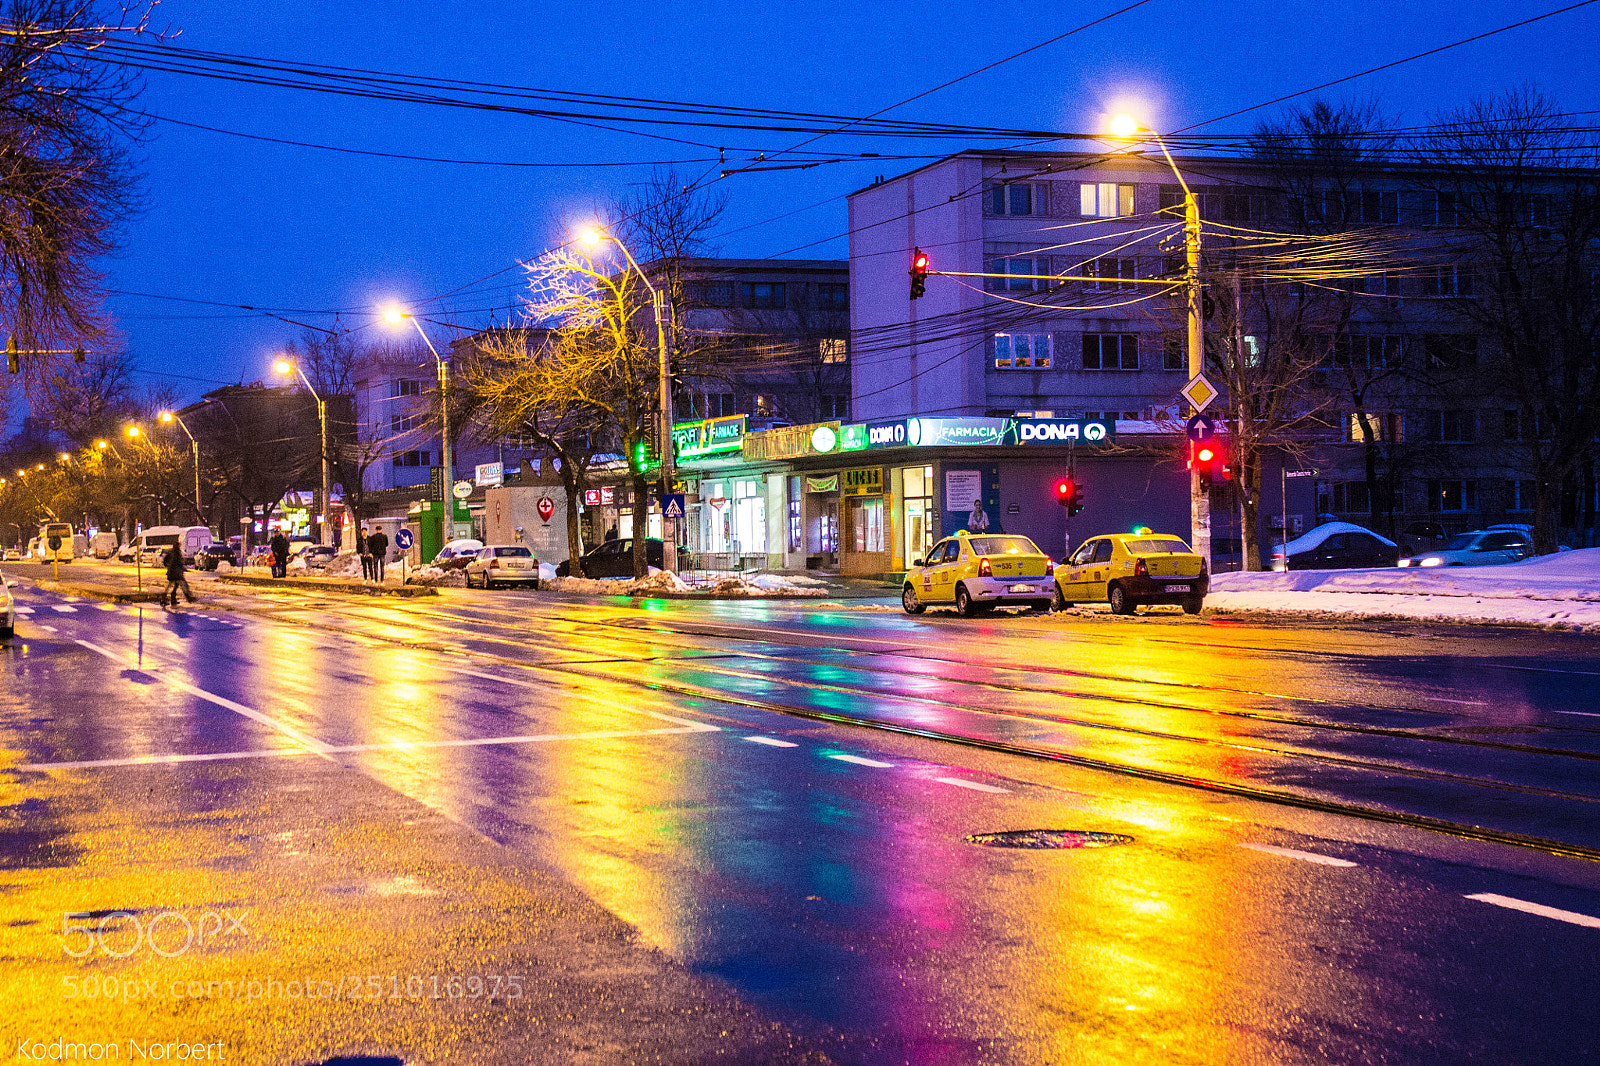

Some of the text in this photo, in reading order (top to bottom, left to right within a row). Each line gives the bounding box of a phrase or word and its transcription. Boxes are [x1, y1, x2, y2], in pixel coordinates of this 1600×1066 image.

[643, 412, 652, 452] TEZAUR
[711, 423, 739, 438] FARMACIE
[869, 425, 894, 444] DONA
[942, 427, 997, 438] FARMACIA
[1020, 423, 1079, 440] DONA
